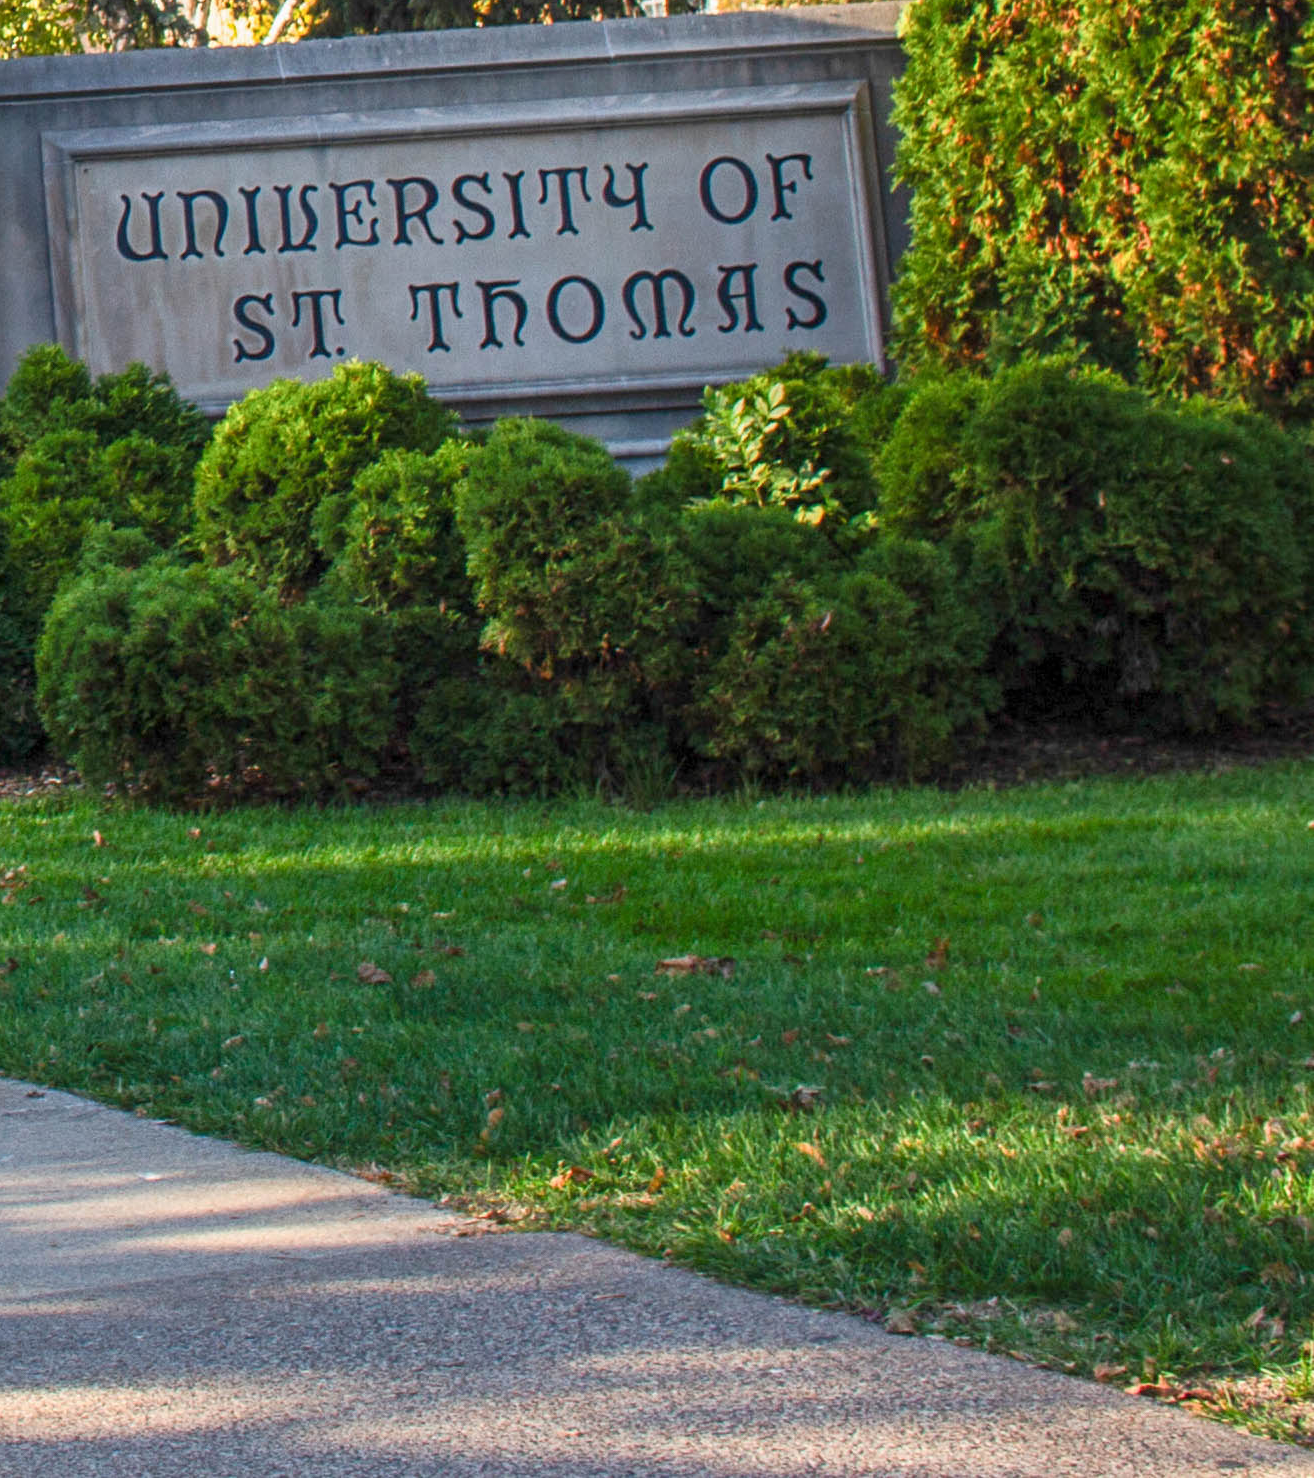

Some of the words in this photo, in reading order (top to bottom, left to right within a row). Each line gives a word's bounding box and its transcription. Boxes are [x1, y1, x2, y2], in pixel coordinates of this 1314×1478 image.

[116, 162, 654, 262] UNIVERSITY
[699, 153, 814, 225] OF
[233, 288, 346, 364] ST.
[408, 259, 828, 354] THOMAS
